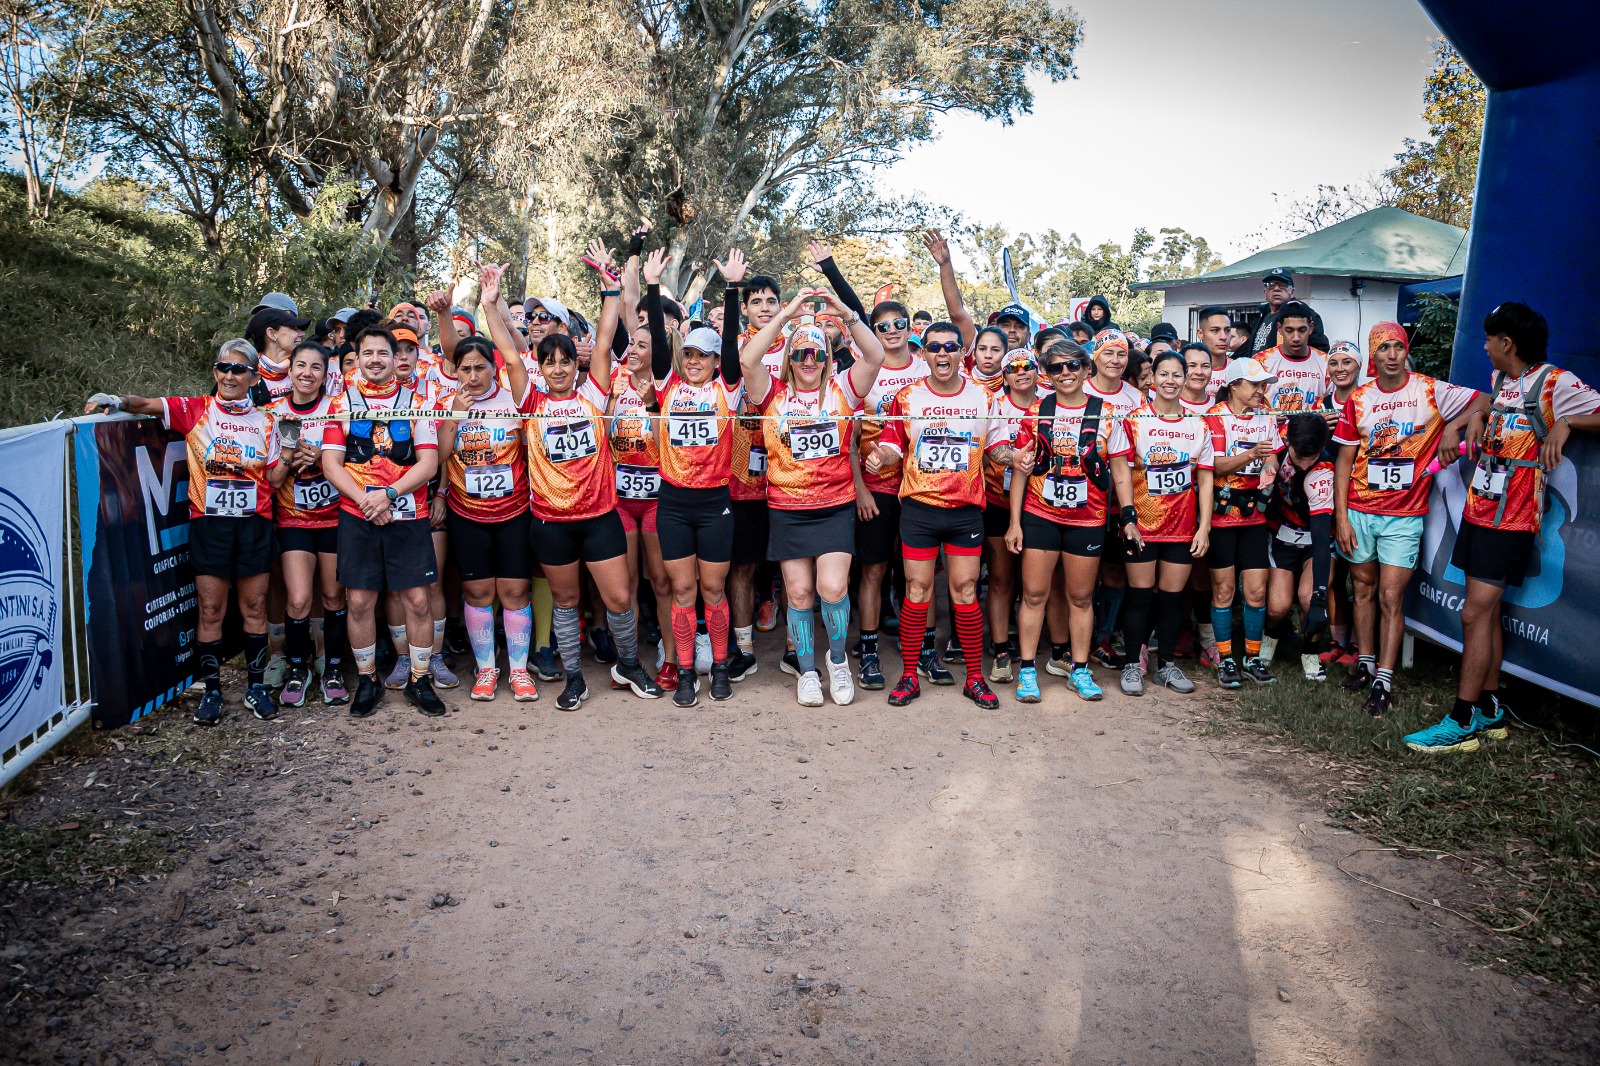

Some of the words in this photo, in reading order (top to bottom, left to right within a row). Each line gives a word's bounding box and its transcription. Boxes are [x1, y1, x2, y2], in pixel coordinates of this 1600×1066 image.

[1279, 387, 1299, 395] GOYA
[1305, 390, 1315, 405] 10
[933, 406, 978, 417] Gigared
[461, 424, 486, 432] GOYA
[493, 427, 506, 442] 10
[678, 421, 710, 439] 415
[923, 427, 951, 436] GOYA
[1157, 429, 1195, 441] Gigared
[1400, 421, 1414, 436] 10
[554, 430, 591, 453] 404
[797, 432, 834, 452] 390
[1149, 445, 1173, 453] GOYA
[244, 444, 256, 459] 10
[928, 445, 962, 464] 376
[474, 474, 507, 492] 122
[621, 474, 655, 492] 355
[1154, 471, 1186, 490] 150
[1381, 467, 1402, 485] 15
[214, 490, 249, 509] 413
[300, 482, 332, 501] 160
[1056, 485, 1078, 501] 48
[1419, 581, 1465, 612] GRAFICA
[1502, 615, 1549, 646] CITARIA
